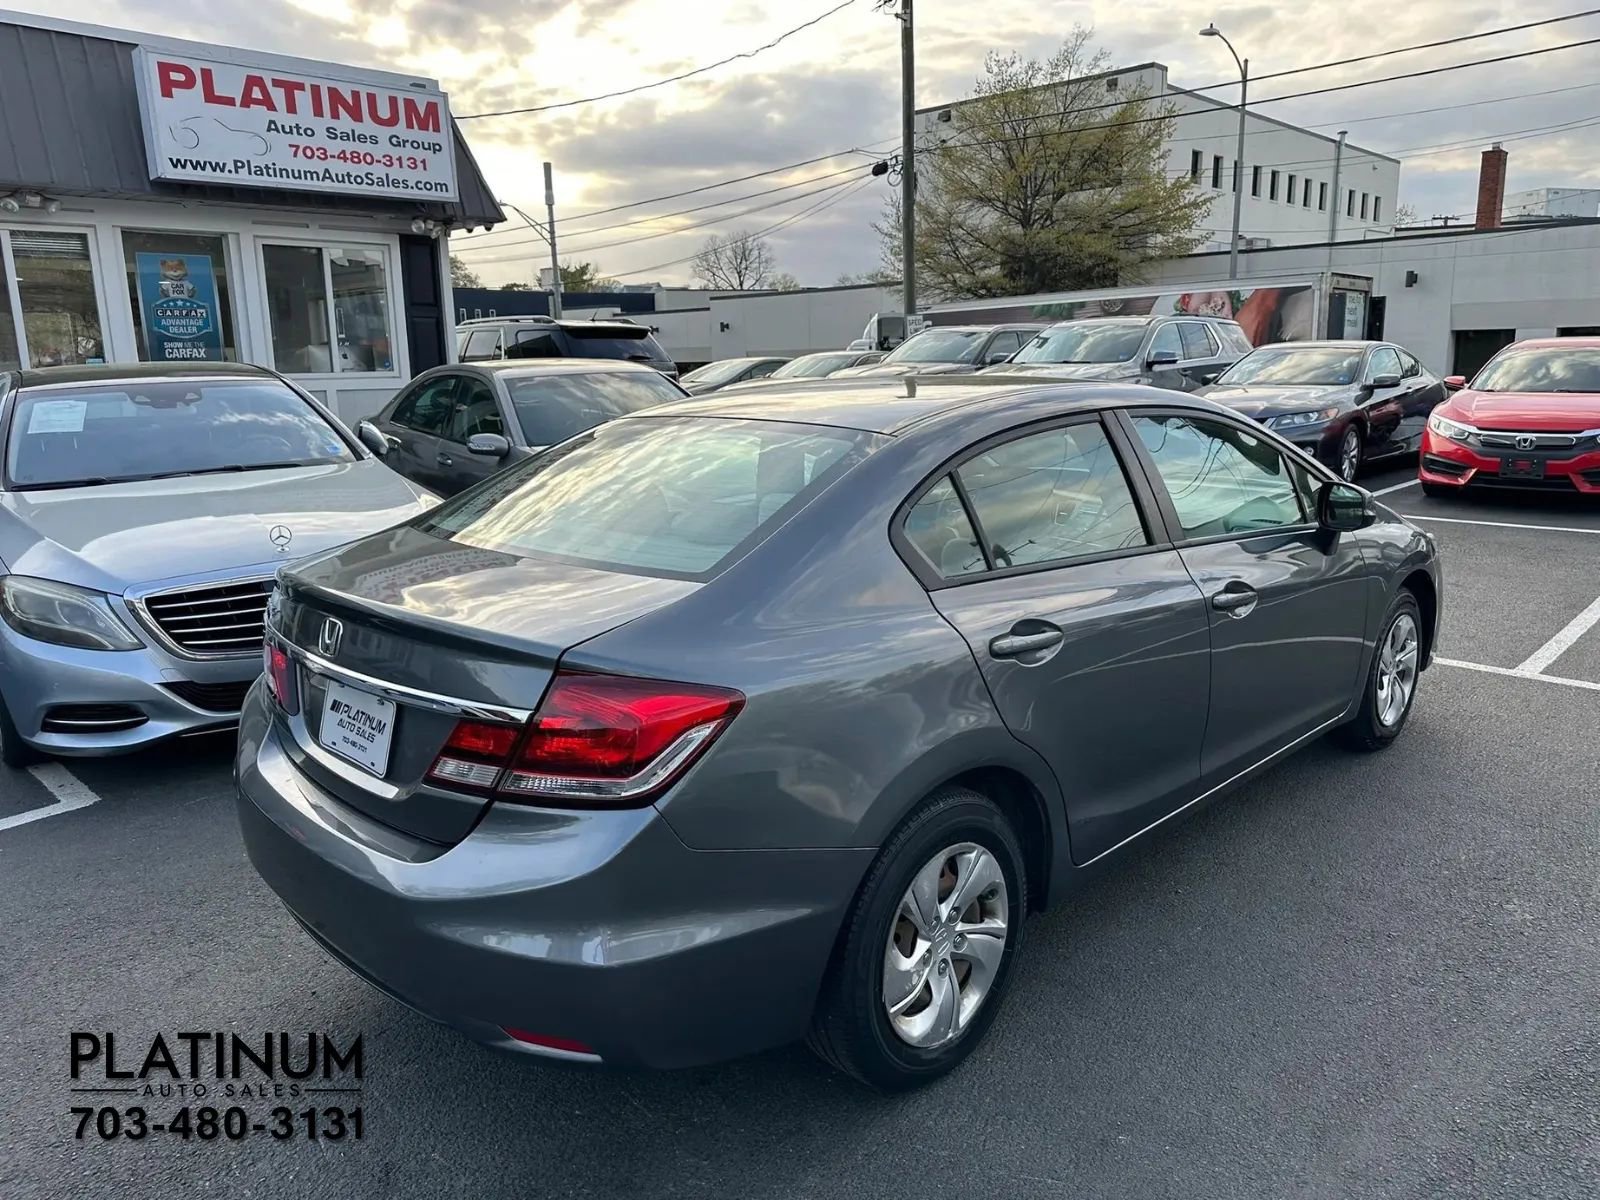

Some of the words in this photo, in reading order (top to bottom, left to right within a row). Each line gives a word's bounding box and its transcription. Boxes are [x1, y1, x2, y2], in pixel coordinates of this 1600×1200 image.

[157, 61, 441, 133] PLATINUM
[266, 119, 315, 138] Auto
[325, 126, 379, 145] Sales
[388, 134, 442, 154] Group
[288, 143, 428, 172] 703-480-3131
[168, 157, 449, 193] www.PlatinumAutoSales.com
[157, 309, 206, 317] CARFAX
[165, 348, 206, 358] CARFAX
[337, 718, 356, 733] AUTO
[355, 726, 376, 743] SALES
[340, 703, 387, 735] PLATINUM
